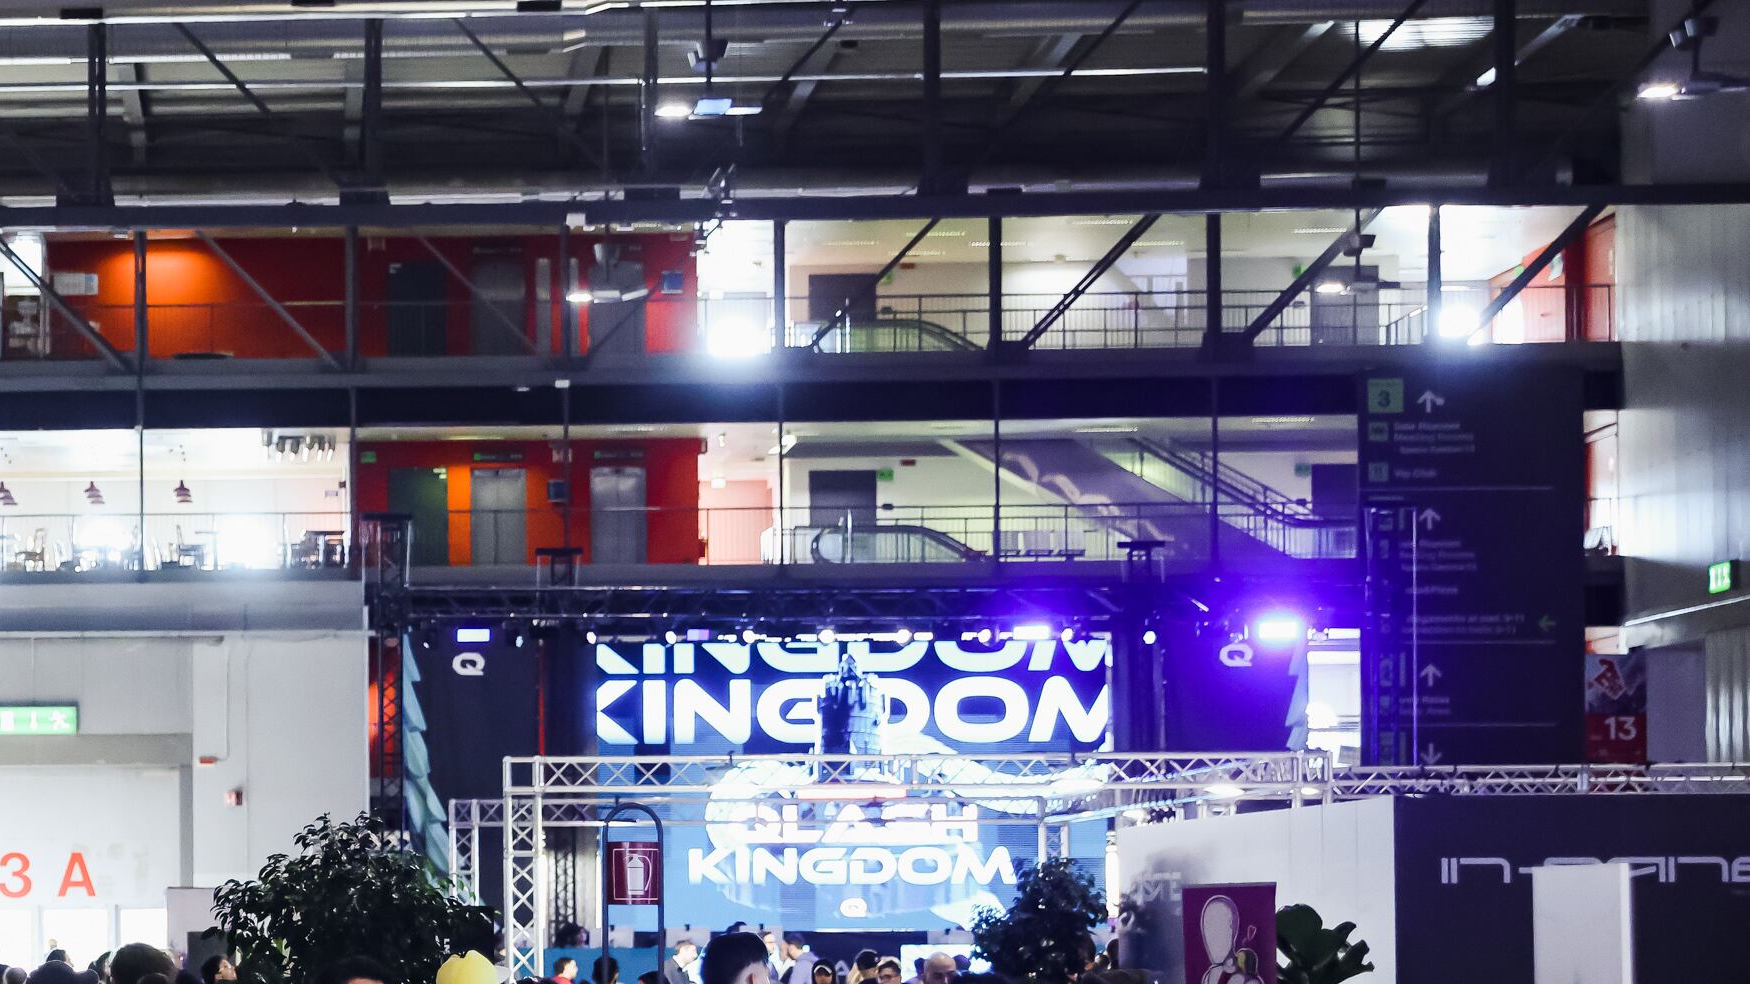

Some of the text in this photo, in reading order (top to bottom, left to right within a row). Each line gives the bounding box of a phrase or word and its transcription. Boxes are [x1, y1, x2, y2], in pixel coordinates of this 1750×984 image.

[1604, 716, 1637, 740] 13
[58, 852, 96, 897] A
[688, 846, 1017, 885] KINGDOM
